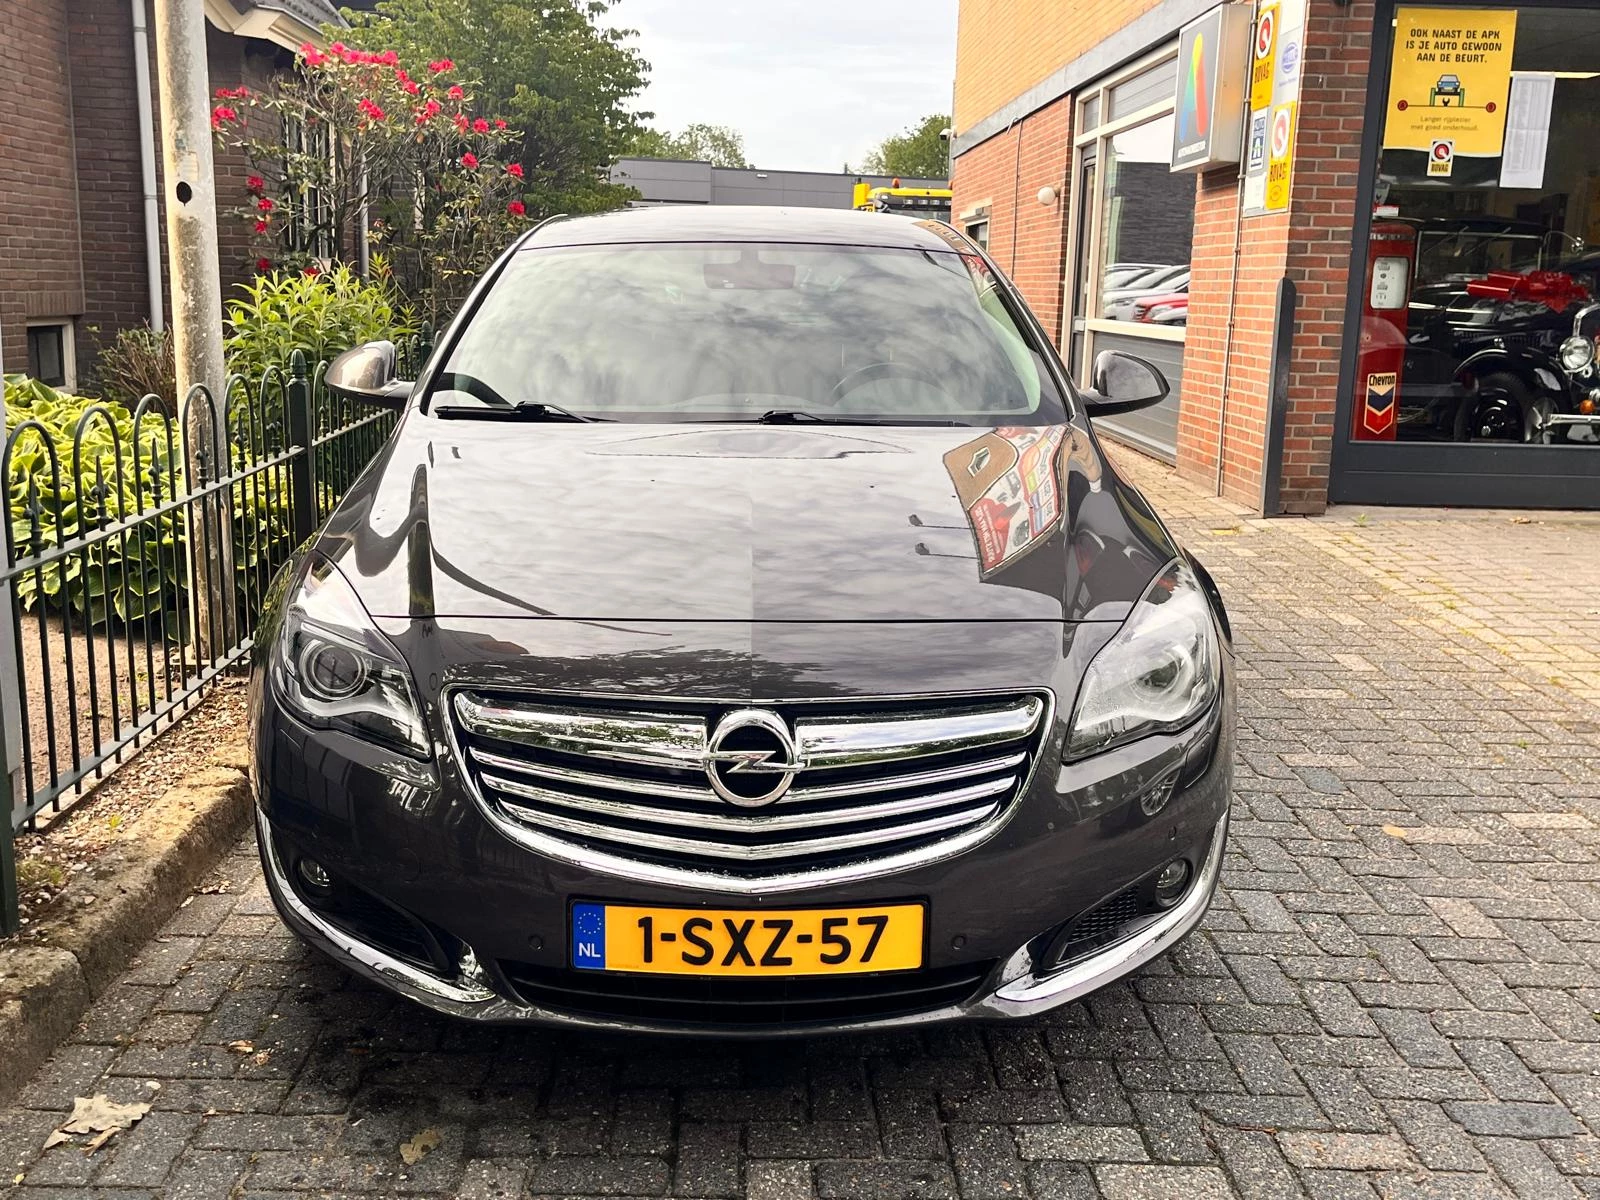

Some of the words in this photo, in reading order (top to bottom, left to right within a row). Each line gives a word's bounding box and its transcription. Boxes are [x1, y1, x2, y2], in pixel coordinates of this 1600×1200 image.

[1410, 28, 1428, 39] OOK
[1432, 29, 1462, 39] NAAST
[1466, 29, 1477, 39] DE
[1481, 29, 1500, 40] APK
[1406, 40, 1414, 50] IS
[1418, 41, 1430, 50] JE
[1433, 41, 1457, 51] AUTO
[1461, 42, 1502, 51] GEWOON
[1416, 53, 1436, 62] AAN
[1439, 54, 1451, 63] DE
[1455, 54, 1488, 64] BEURT.
[1369, 374, 1396, 387] Chevron
[638, 915, 889, 967] 1-SXZ-57
[578, 942, 601, 958] NL
